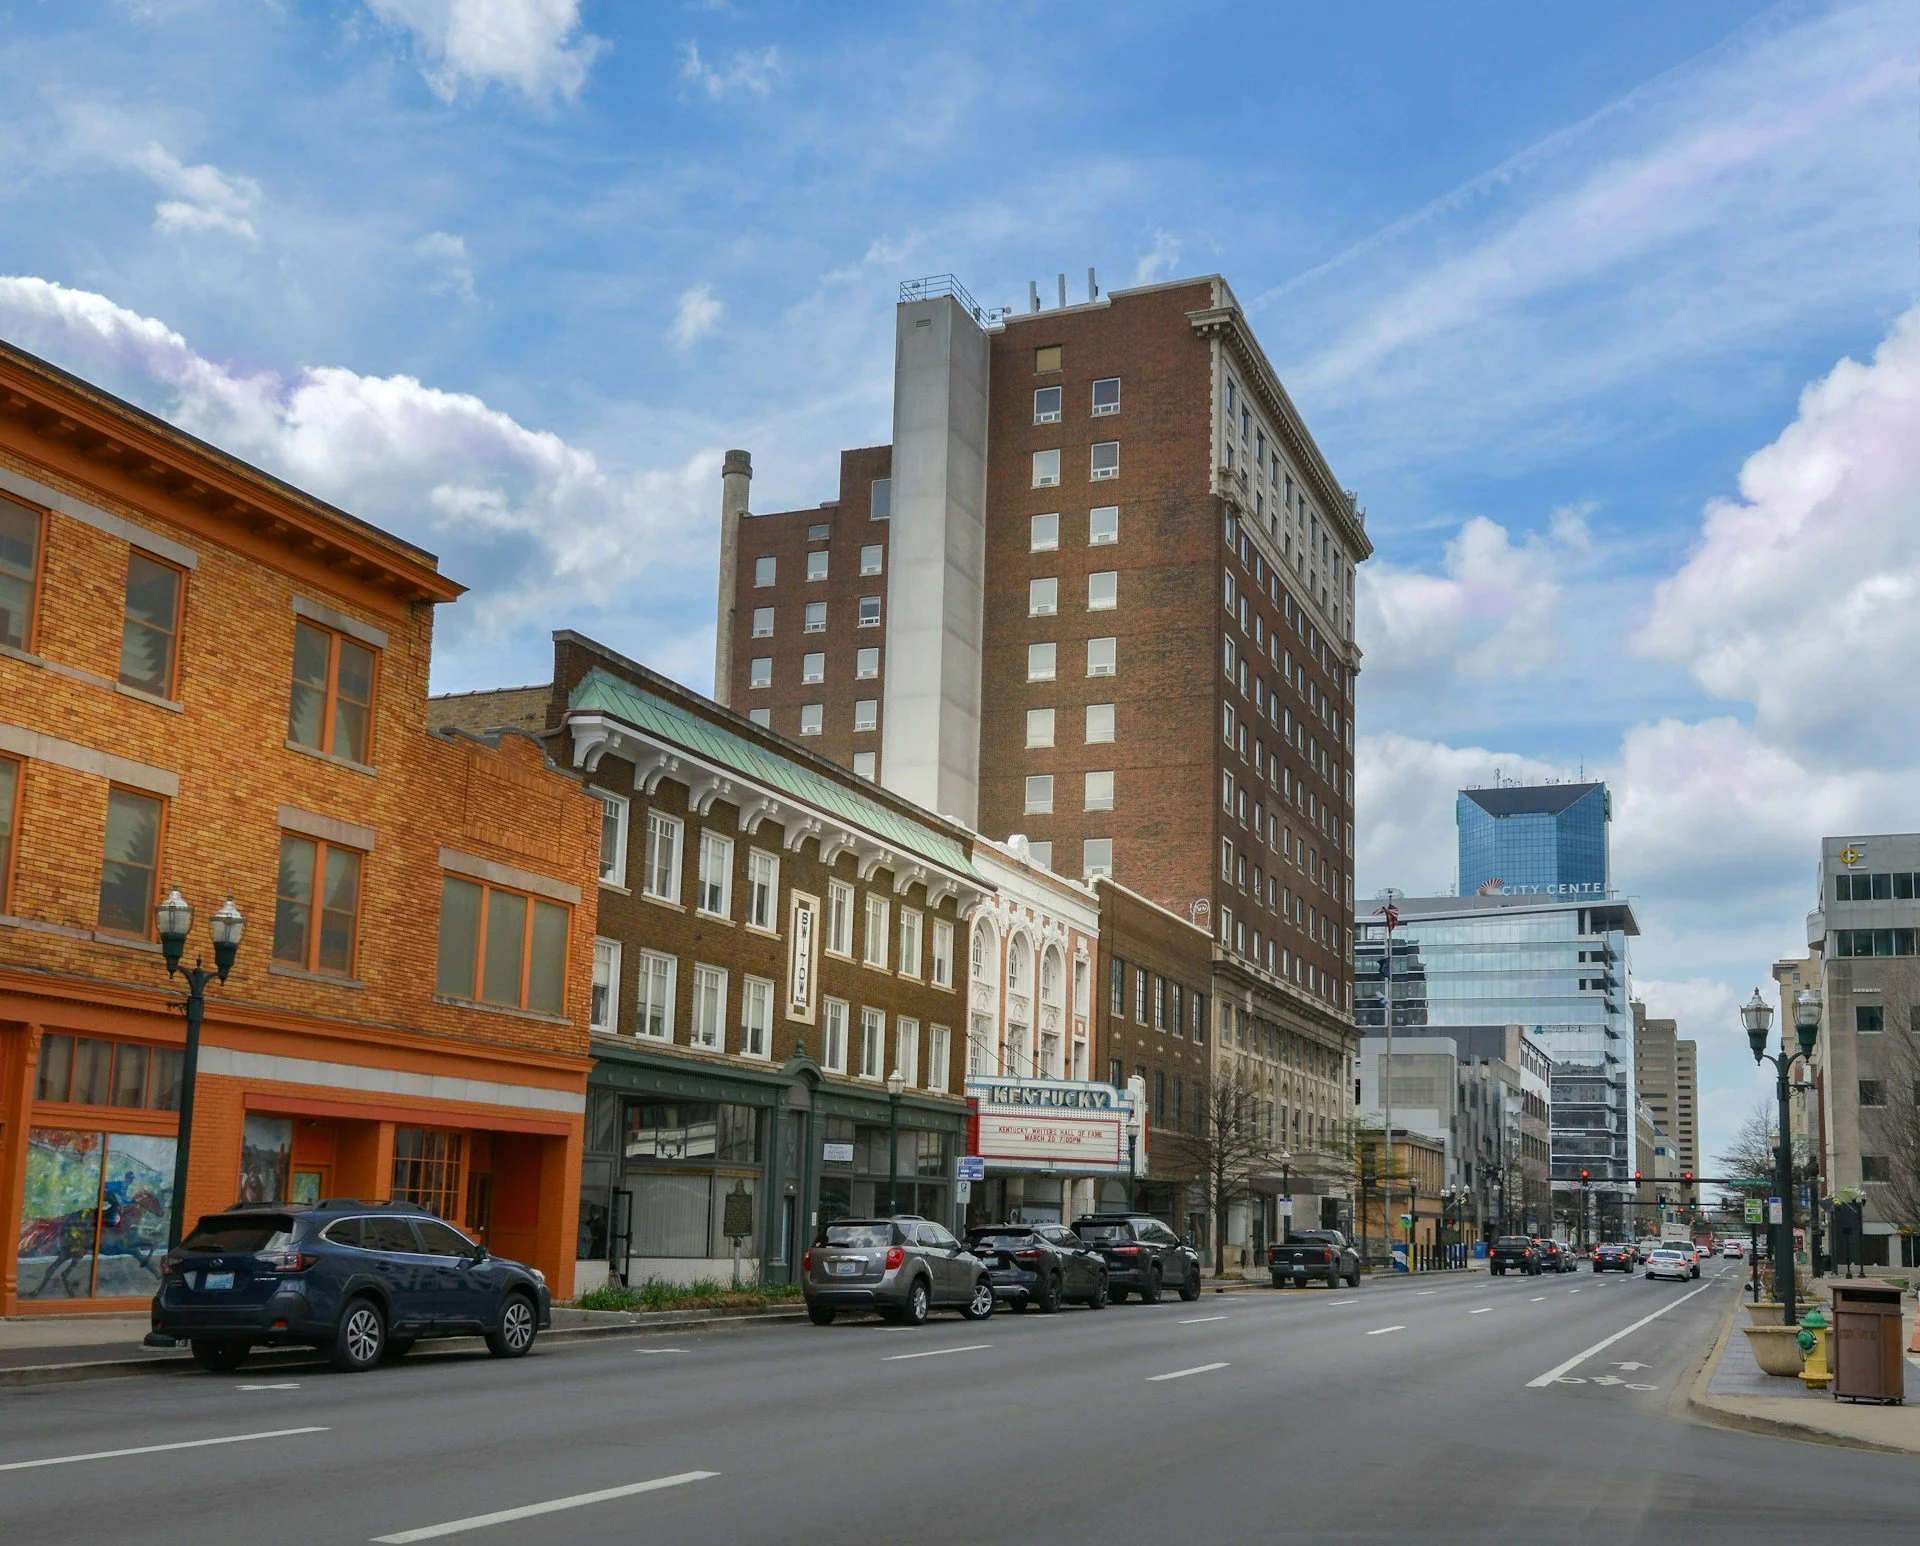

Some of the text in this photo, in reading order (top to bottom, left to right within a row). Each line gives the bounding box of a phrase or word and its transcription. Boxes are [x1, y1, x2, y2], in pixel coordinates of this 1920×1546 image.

[1502, 885, 1540, 896] CITY
[992, 1086, 1106, 1108] KENTUCKY
[999, 1125, 1029, 1135] KENTUCKY
[1032, 1128, 1057, 1136] WRITERS
[1060, 1129, 1075, 1137] HALL
[1025, 1134, 1081, 1144] MARCH 20 7:00PM
